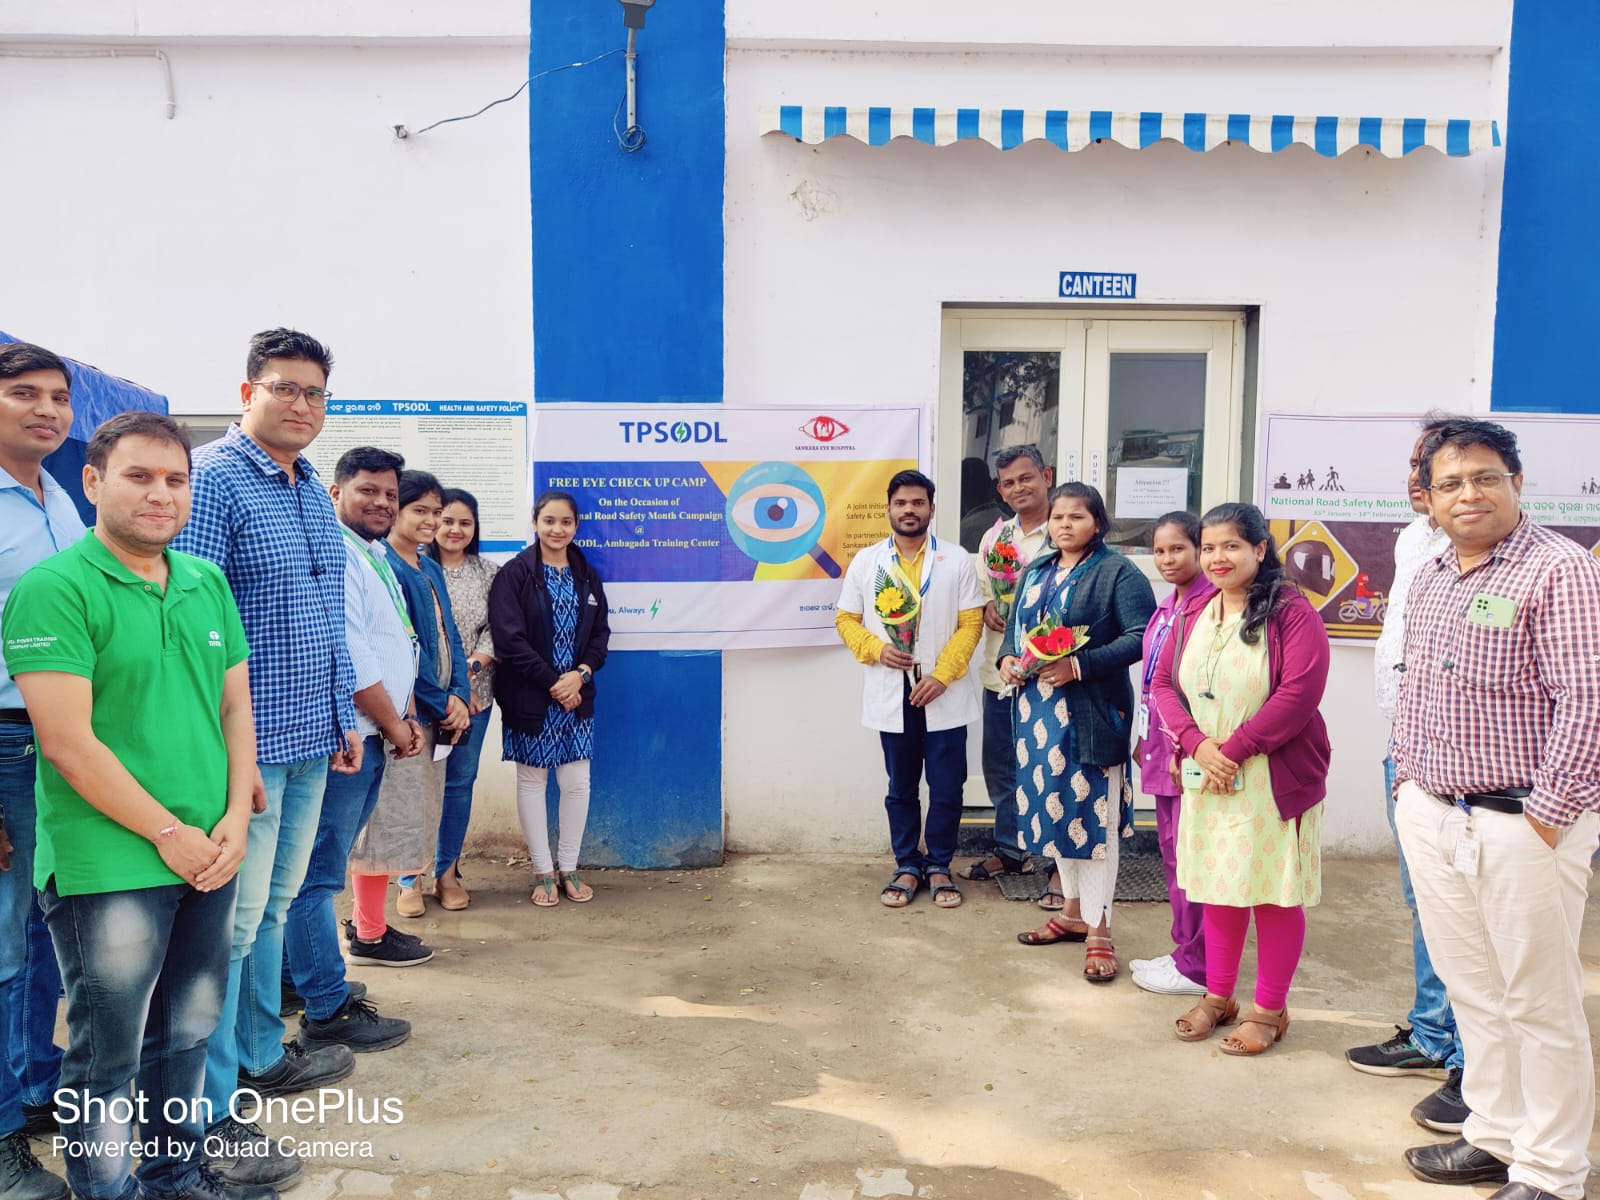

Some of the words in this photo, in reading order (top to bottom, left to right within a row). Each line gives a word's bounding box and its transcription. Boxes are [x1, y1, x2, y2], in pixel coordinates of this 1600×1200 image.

[1062, 274, 1132, 296] CANTEEN
[392, 402, 431, 412] TPSODL
[439, 404, 462, 412] HEALTH
[462, 404, 475, 412] AND
[475, 404, 498, 412] SAFETY
[499, 404, 520, 413] POLICY
[619, 421, 728, 444] TPSODL
[548, 477, 580, 488] FREE
[582, 477, 607, 488] EYE
[608, 477, 652, 488] CHECK
[654, 477, 671, 488] UP
[671, 477, 707, 488] CAMP
[598, 497, 612, 506] On
[614, 497, 629, 506] the
[629, 497, 669, 507] Occasion
[670, 497, 681, 506] of
[852, 503, 868, 511] joint
[1271, 496, 1314, 506] National
[1316, 497, 1340, 507] Road
[1343, 498, 1374, 509] Safety
[1376, 499, 1411, 509] Month
[594, 511, 617, 521] Road
[618, 511, 646, 522] Safety
[648, 511, 676, 521] Month
[678, 511, 723, 523] Campaign
[634, 526, 645, 535] @
[853, 531, 890, 540] partnership
[572, 539, 603, 549] SODL,
[604, 539, 650, 550] Ambagada
[652, 538, 690, 549] Training
[690, 538, 720, 548] Center
[618, 606, 645, 615] Always
